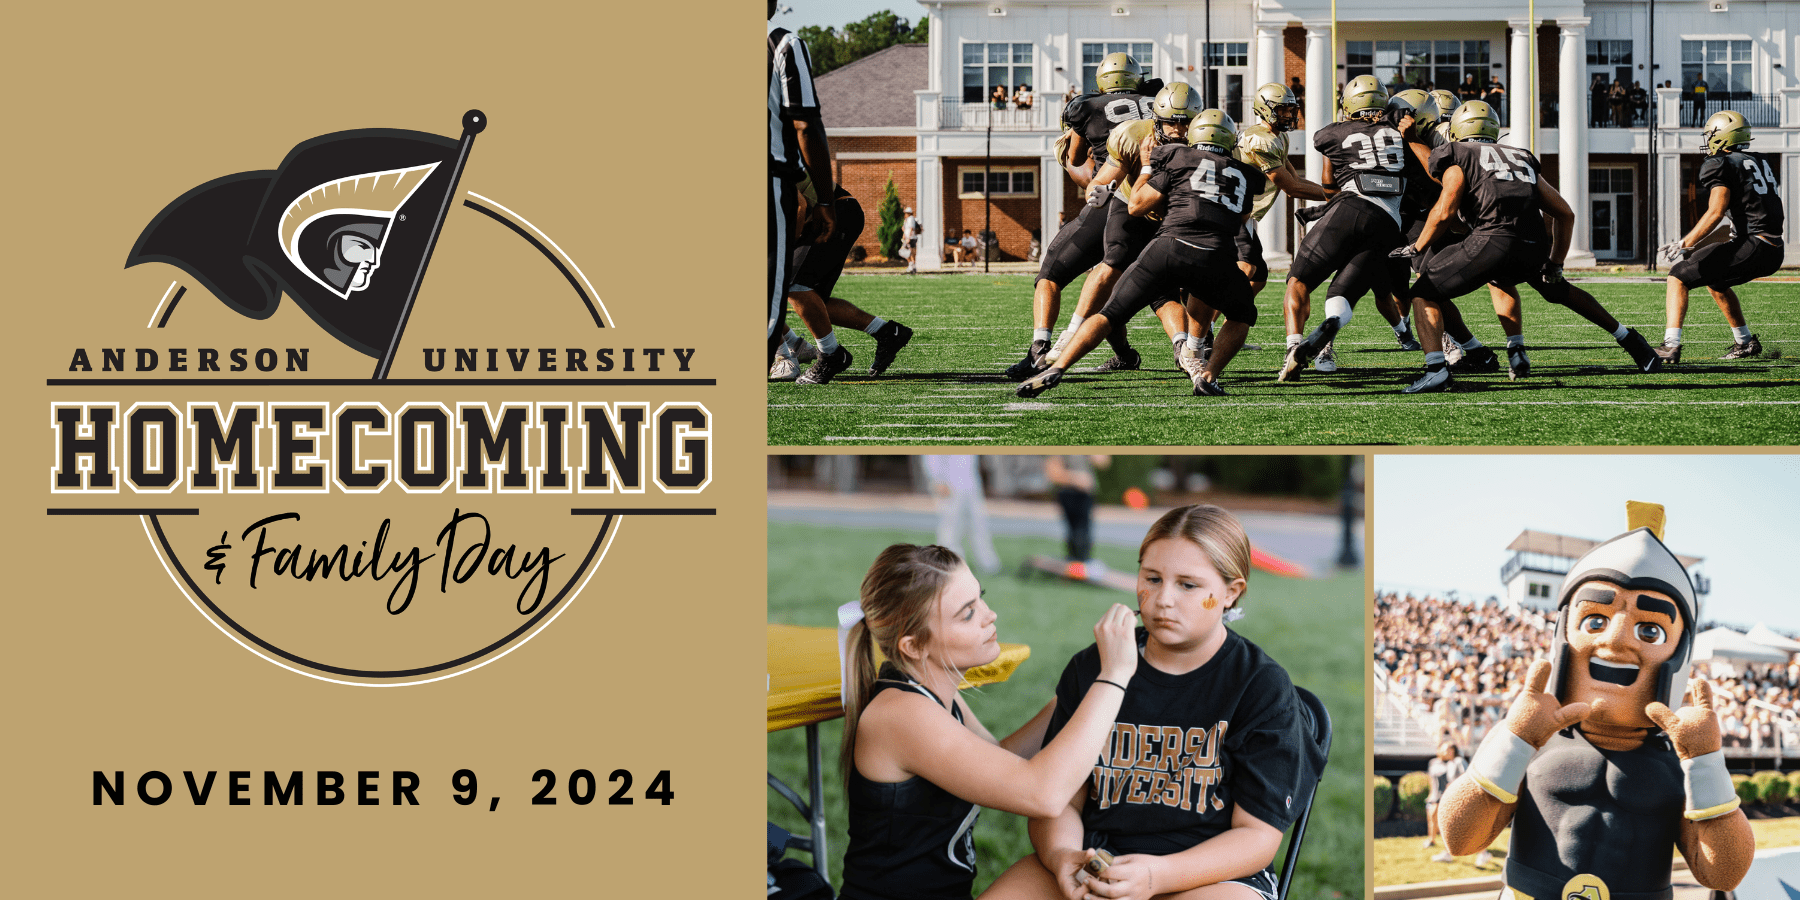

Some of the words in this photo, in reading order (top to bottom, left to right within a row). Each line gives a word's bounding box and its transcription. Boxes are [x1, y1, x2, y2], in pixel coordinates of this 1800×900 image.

[1196, 144, 1224, 154] Riddell
[1342, 127, 1404, 172] 38
[1479, 145, 1537, 184] 45
[1189, 158, 1248, 214] 43
[1743, 159, 1779, 195] 34
